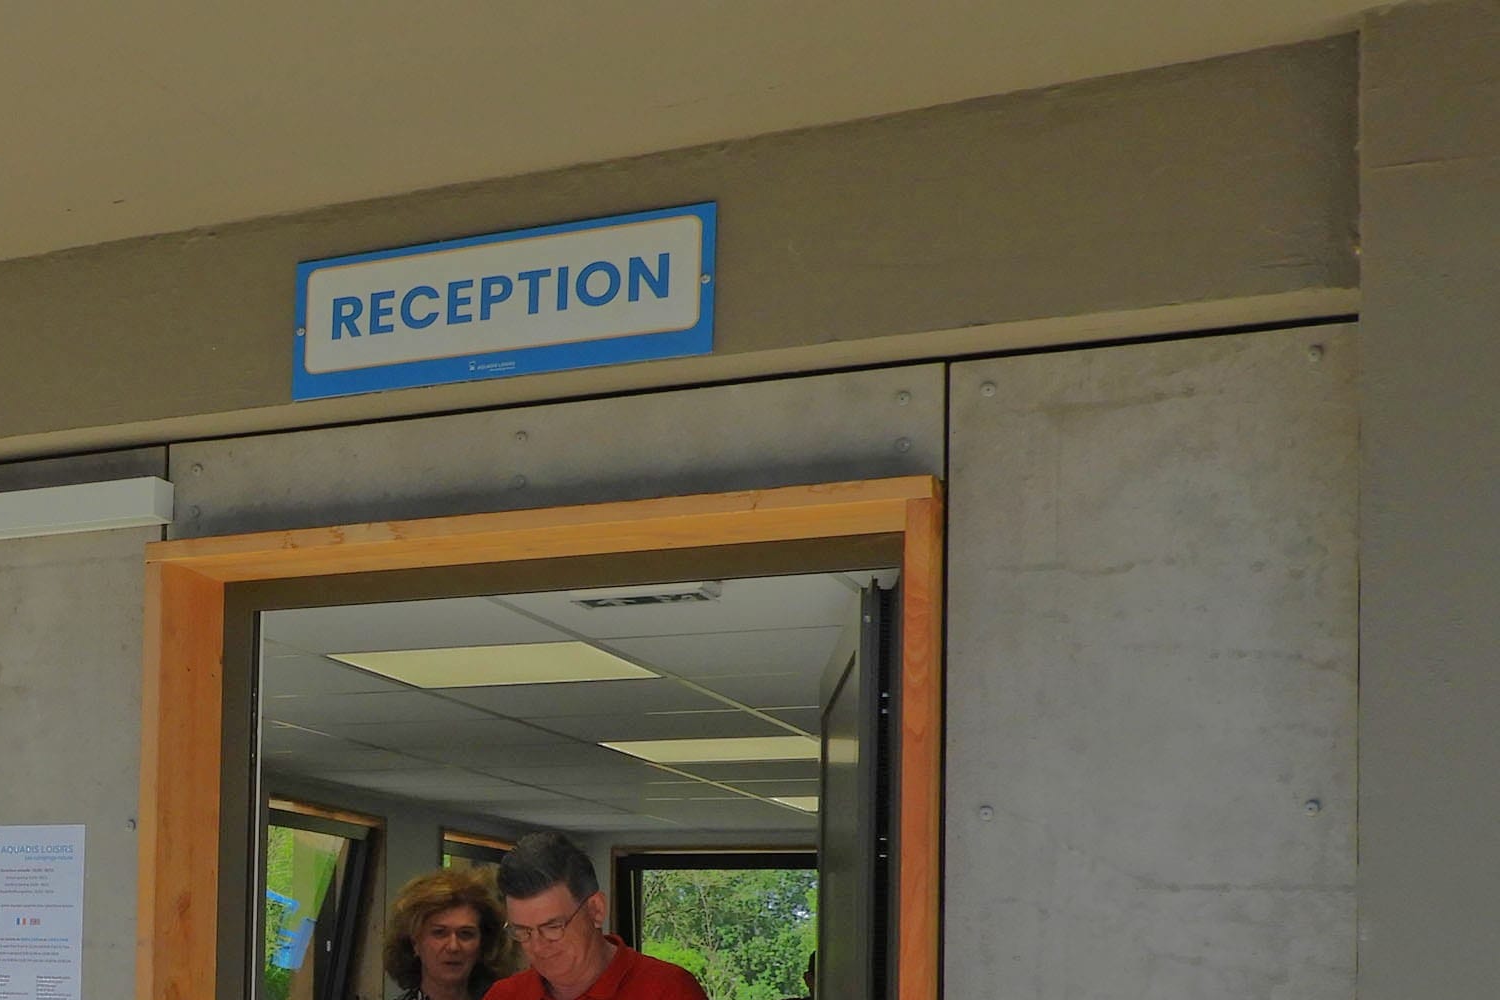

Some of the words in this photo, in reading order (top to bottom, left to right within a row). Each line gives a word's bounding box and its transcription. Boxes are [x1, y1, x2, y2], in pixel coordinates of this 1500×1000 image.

[331, 253, 671, 341] RECEPTION
[0, 845, 39, 854] AQUADIS
[41, 845, 74, 854] LOISIRS
